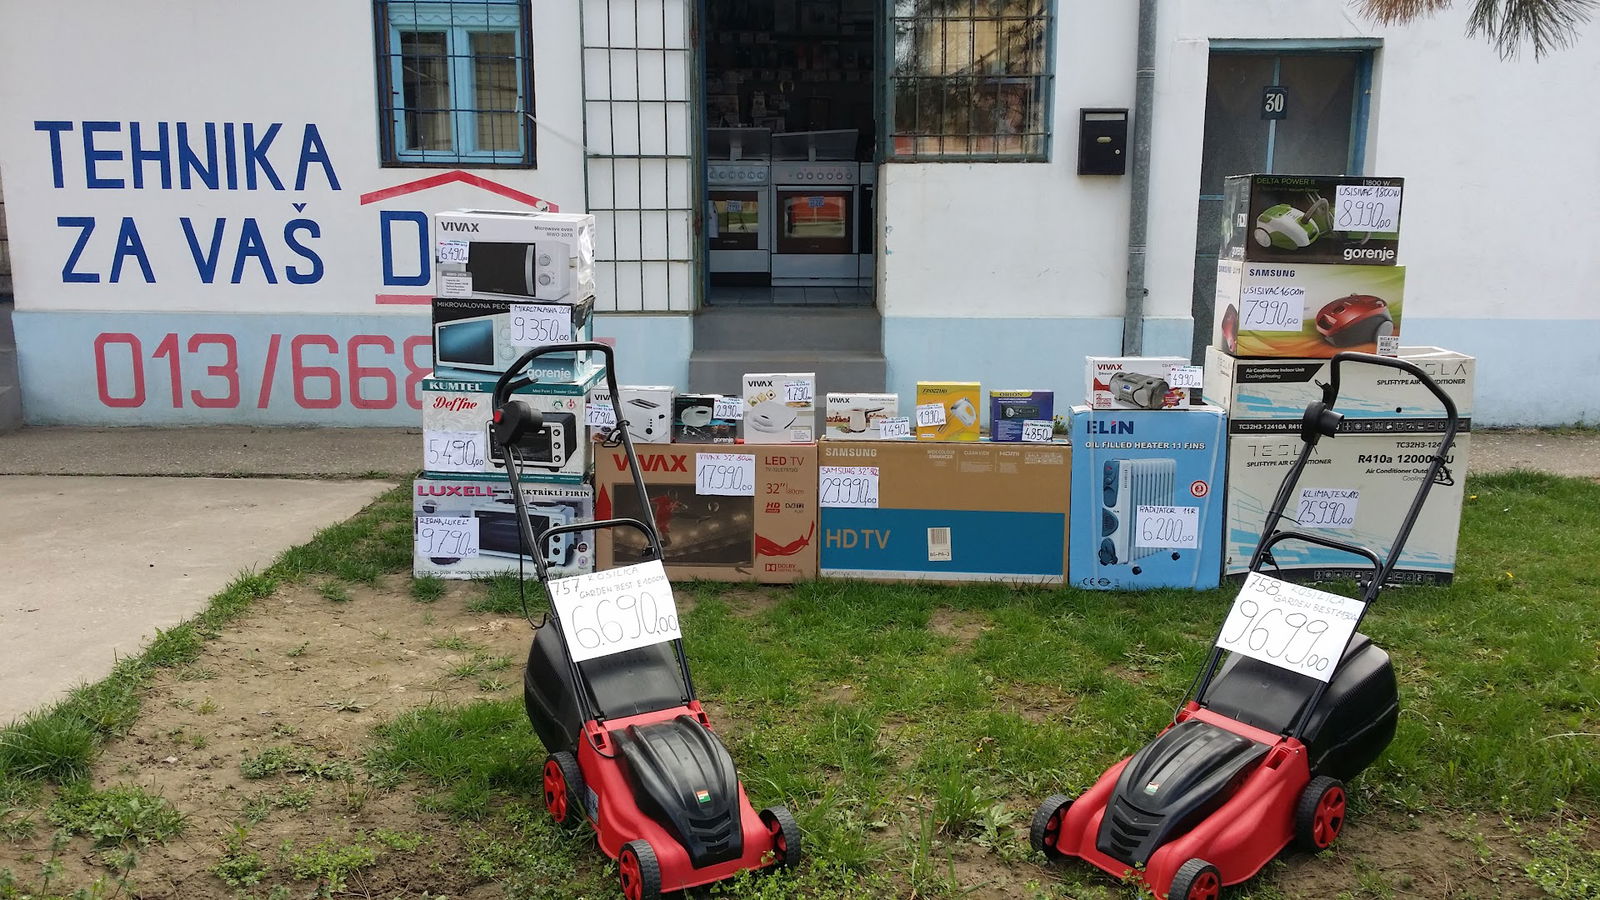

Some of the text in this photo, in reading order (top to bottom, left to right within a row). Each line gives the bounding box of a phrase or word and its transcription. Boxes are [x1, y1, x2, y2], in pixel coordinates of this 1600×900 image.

[1265, 93, 1284, 113] 30
[34, 120, 342, 192] TEHNIKA
[441, 221, 480, 232] VIVAX
[57, 202, 431, 287] ZA VAŠ D
[1344, 246, 1395, 262] gorenje
[1249, 268, 1296, 277] SAMSUNG
[527, 367, 572, 382] gorenje
[429, 381, 481, 391] KUMTEL
[432, 396, 478, 412] Deffne
[825, 447, 877, 457] SAMSUNG
[1085, 441, 1100, 449] OIL
[613, 453, 688, 472] VVAX
[765, 456, 805, 466] LED TV
[1358, 455, 1393, 464] R410a
[417, 485, 498, 497] LUXELL
[565, 490, 590, 498] FIRIN
[825, 528, 892, 550] HD TV
[550, 578, 580, 596] 757
[614, 581, 634, 592] BEST
[1248, 573, 1282, 596] 758
[1273, 594, 1312, 609] GARDEN
[1312, 604, 1337, 616] BEST
